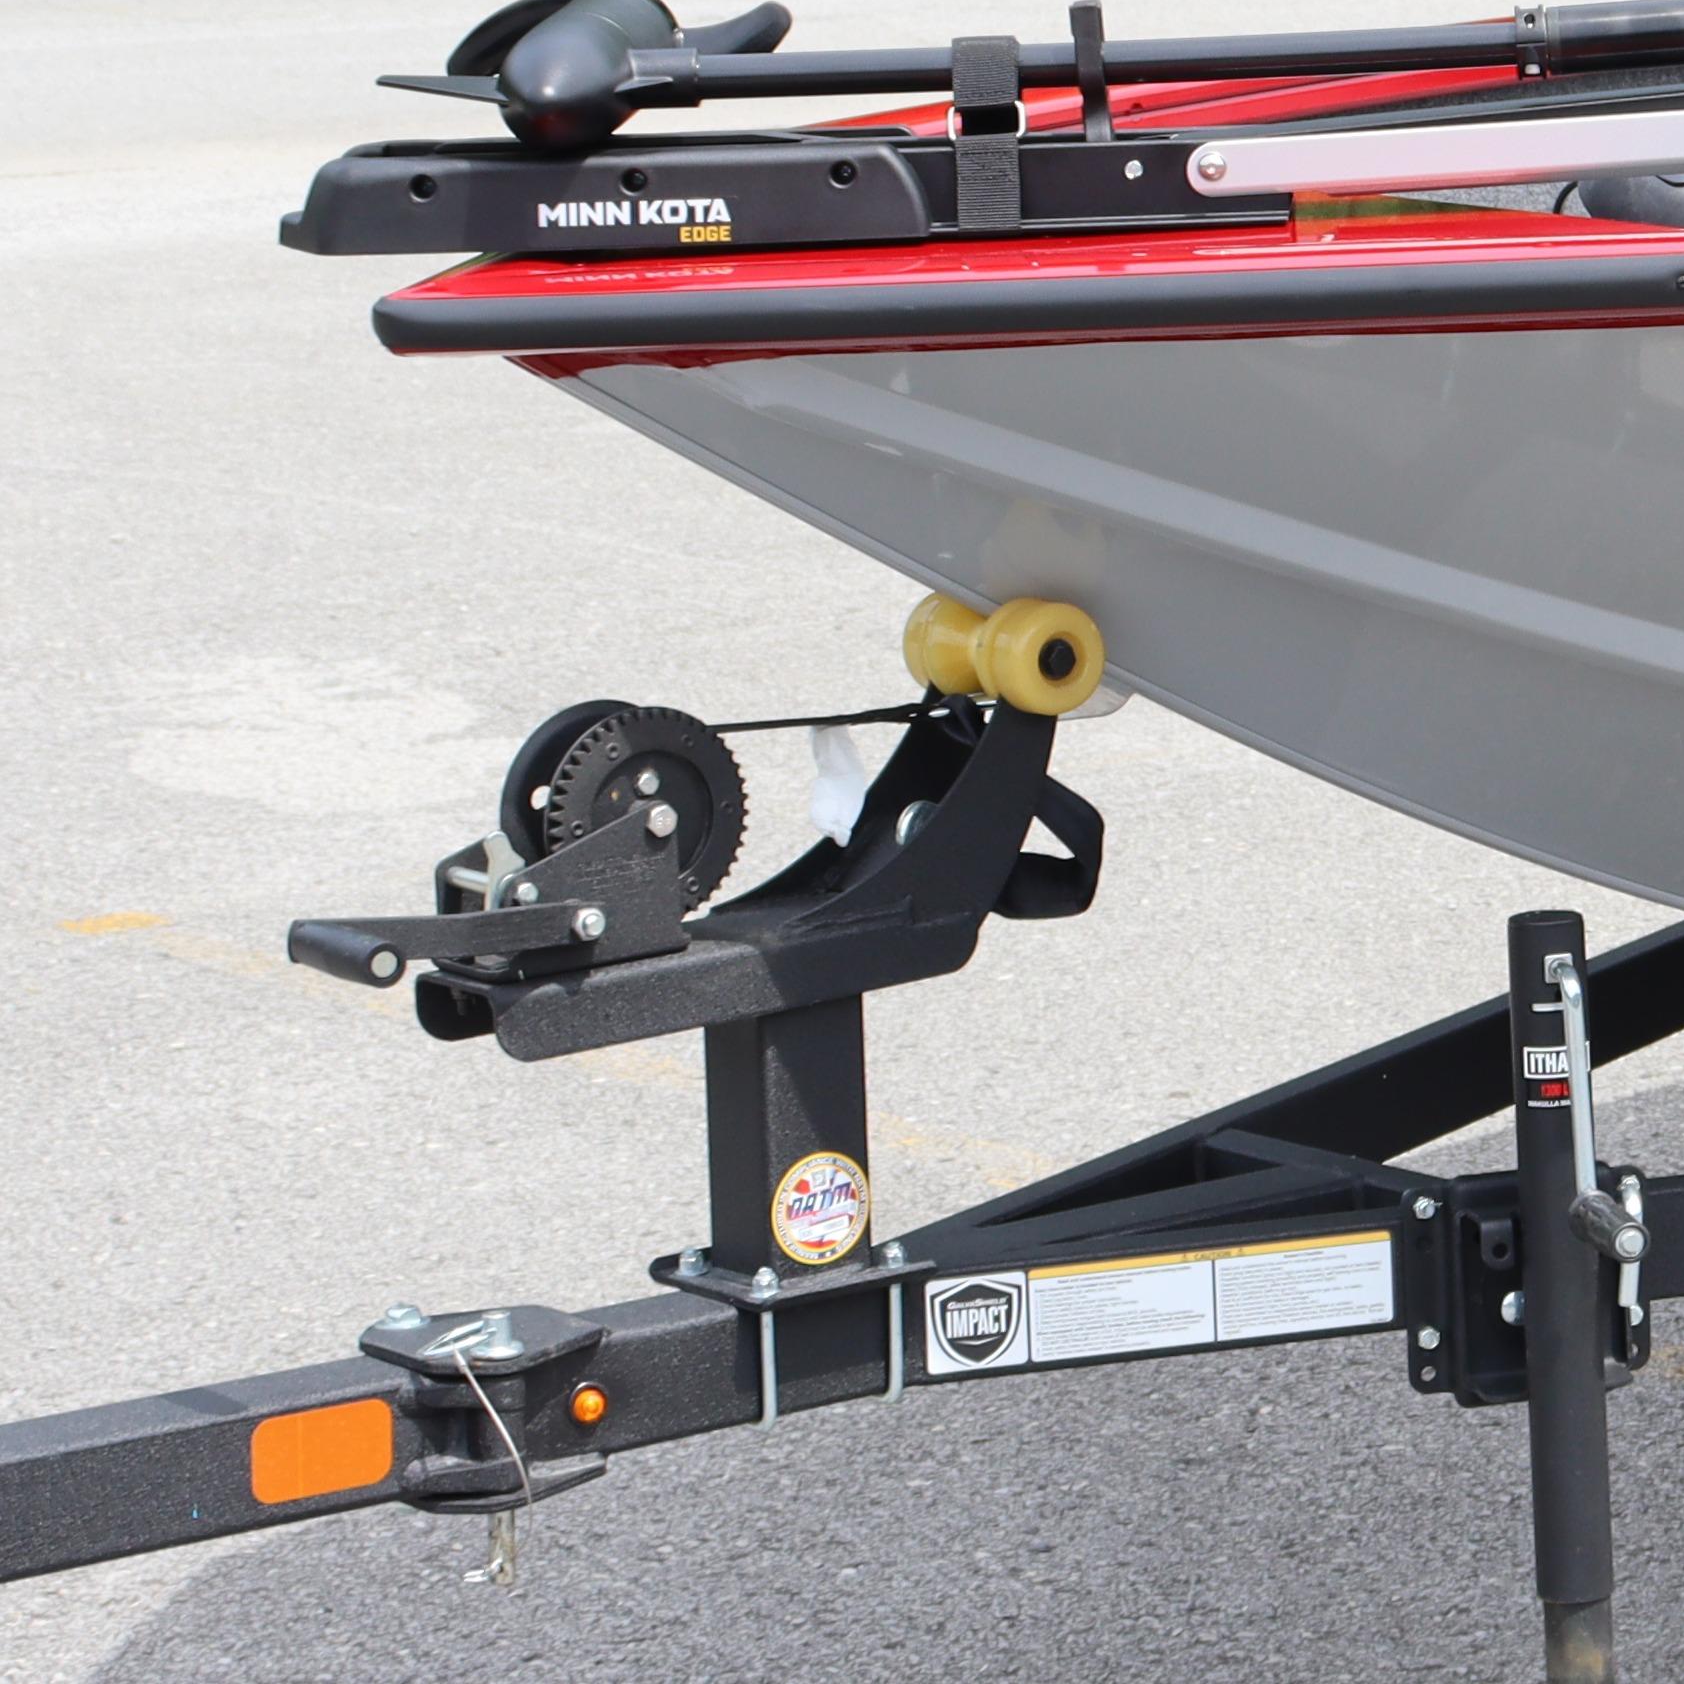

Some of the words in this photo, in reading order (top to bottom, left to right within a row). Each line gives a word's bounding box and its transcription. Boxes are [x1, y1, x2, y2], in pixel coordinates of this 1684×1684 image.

[537, 201, 631, 227] MINN
[638, 198, 732, 224] KOTA
[679, 225, 732, 242] EDGE
[1529, 1052, 1570, 1073] ITHA
[945, 1304, 1008, 1339] IMPACT
